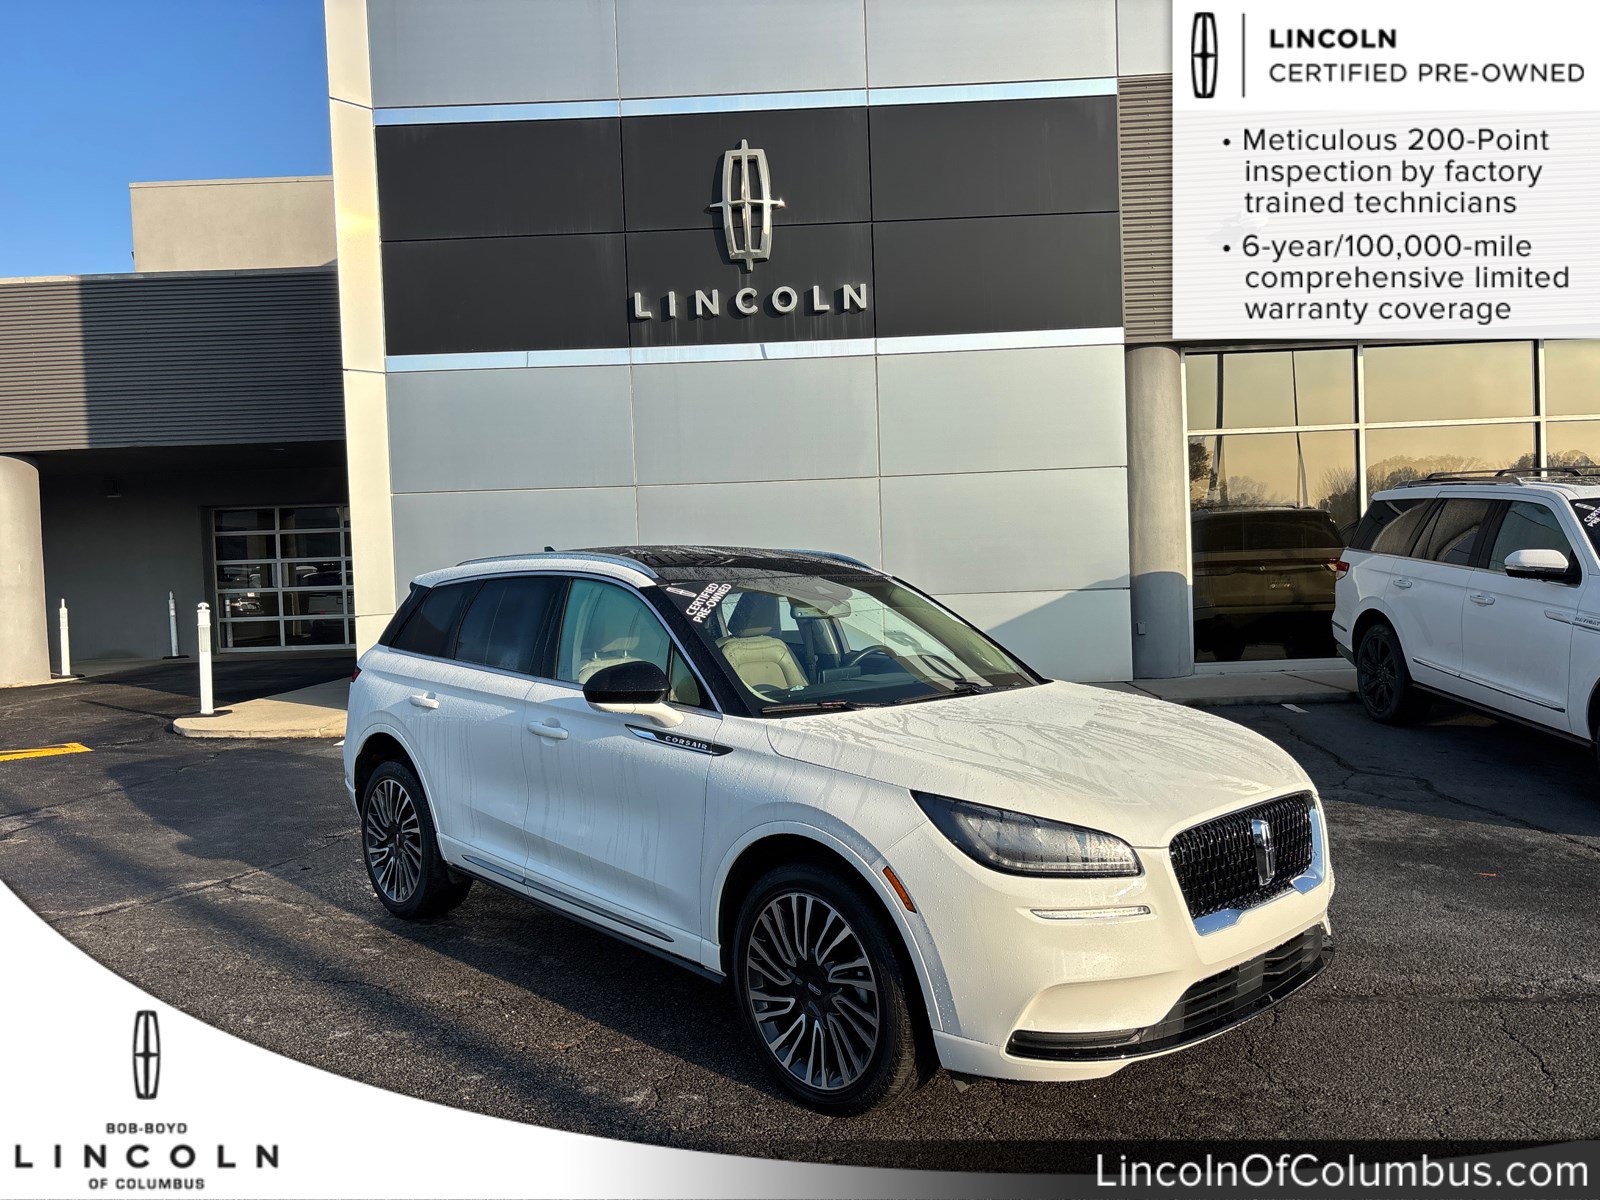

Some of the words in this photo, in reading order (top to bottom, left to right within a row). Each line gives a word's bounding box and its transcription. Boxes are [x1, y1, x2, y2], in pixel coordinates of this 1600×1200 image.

[634, 283, 867, 319] LINCOLN
[686, 583, 719, 616] CERTIFIED
[693, 583, 732, 623] PRE-OWNED
[665, 735, 708, 750] CORSAIR
